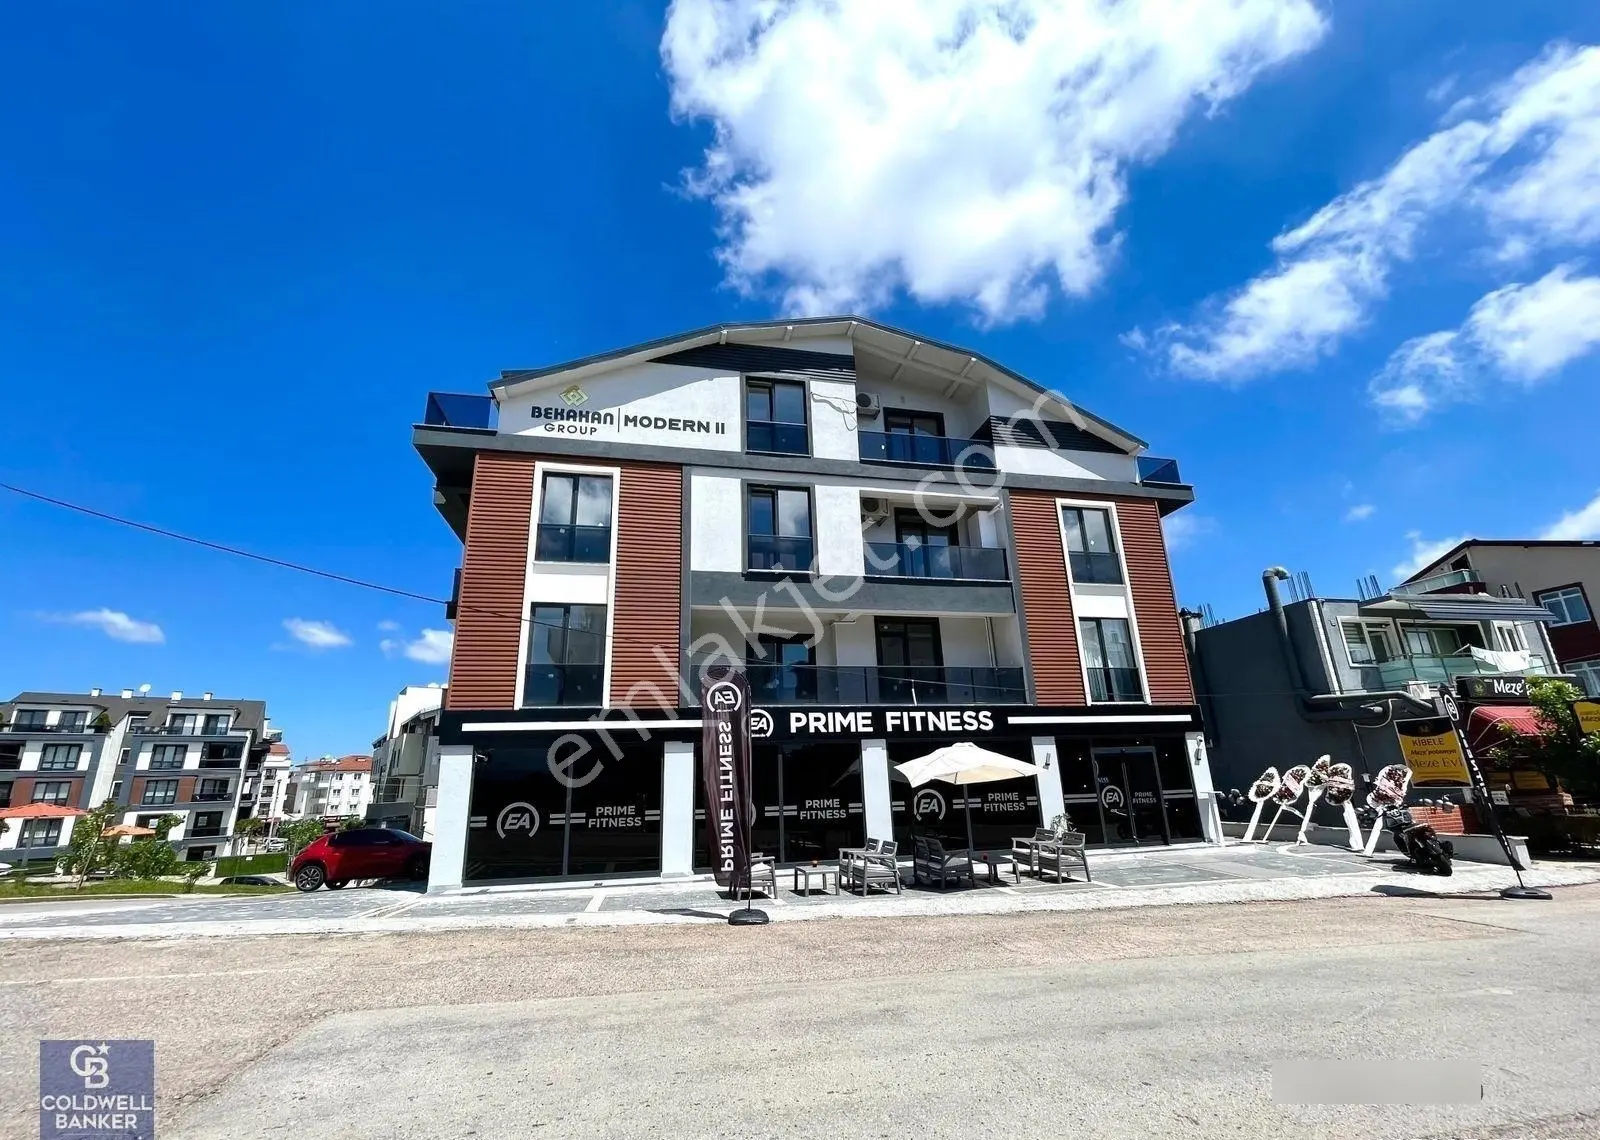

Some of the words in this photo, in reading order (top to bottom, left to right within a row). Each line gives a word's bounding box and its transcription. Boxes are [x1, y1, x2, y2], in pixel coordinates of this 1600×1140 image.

[530, 405, 614, 426] BEKAHAN
[543, 423, 598, 436] GROUP
[623, 413, 711, 434] MODERN
[789, 711, 874, 734] PRIME
[885, 710, 994, 732] FITNESS
[987, 792, 1019, 802] PRIME
[805, 798, 841, 809] PRIME
[983, 801, 1026, 812] FITNESS
[596, 805, 636, 817] PRIME
[799, 809, 847, 820] FITNESS
[588, 816, 642, 829] FITNESS
